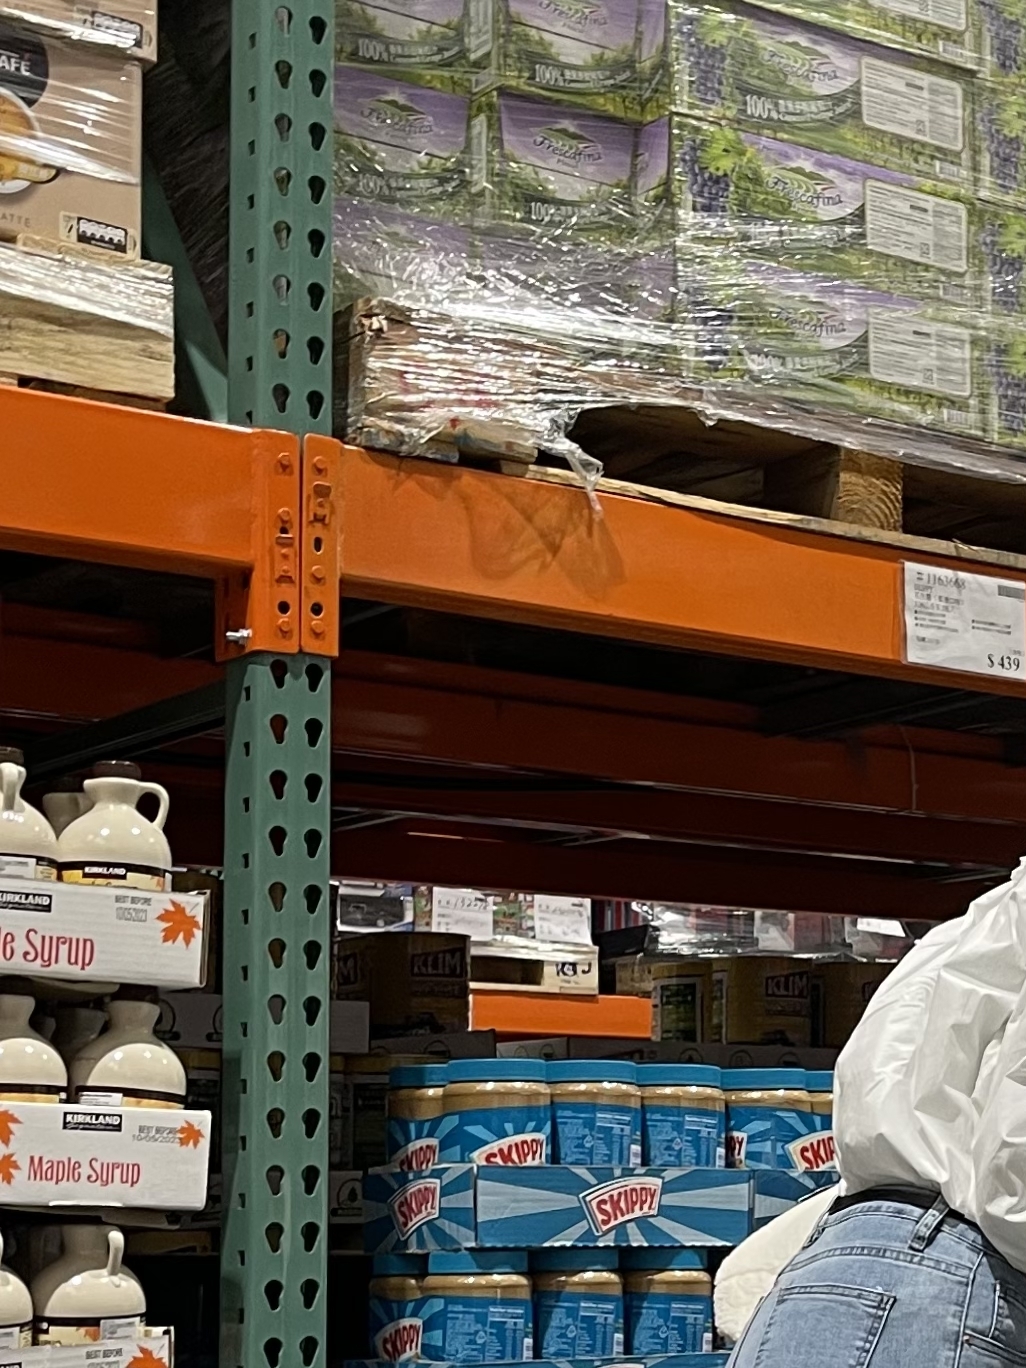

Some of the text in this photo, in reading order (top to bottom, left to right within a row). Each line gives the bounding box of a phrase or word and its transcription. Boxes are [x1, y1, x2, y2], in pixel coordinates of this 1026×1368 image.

[997, 655, 1020, 672] 439
[84, 866, 126, 876] KIRKLAND
[23, 928, 95, 970] Syrup
[413, 950, 461, 975] KLIM
[767, 974, 808, 997] KLIM
[65, 1114, 121, 1125] KIRKLAND
[484, 1134, 546, 1165] SKIPPY
[28, 1155, 141, 1187] Maple Syrup
[396, 1184, 439, 1227] SKIPPY
[596, 1186, 659, 1228] SKIPPY
[381, 1322, 421, 1361] SKIPPY
